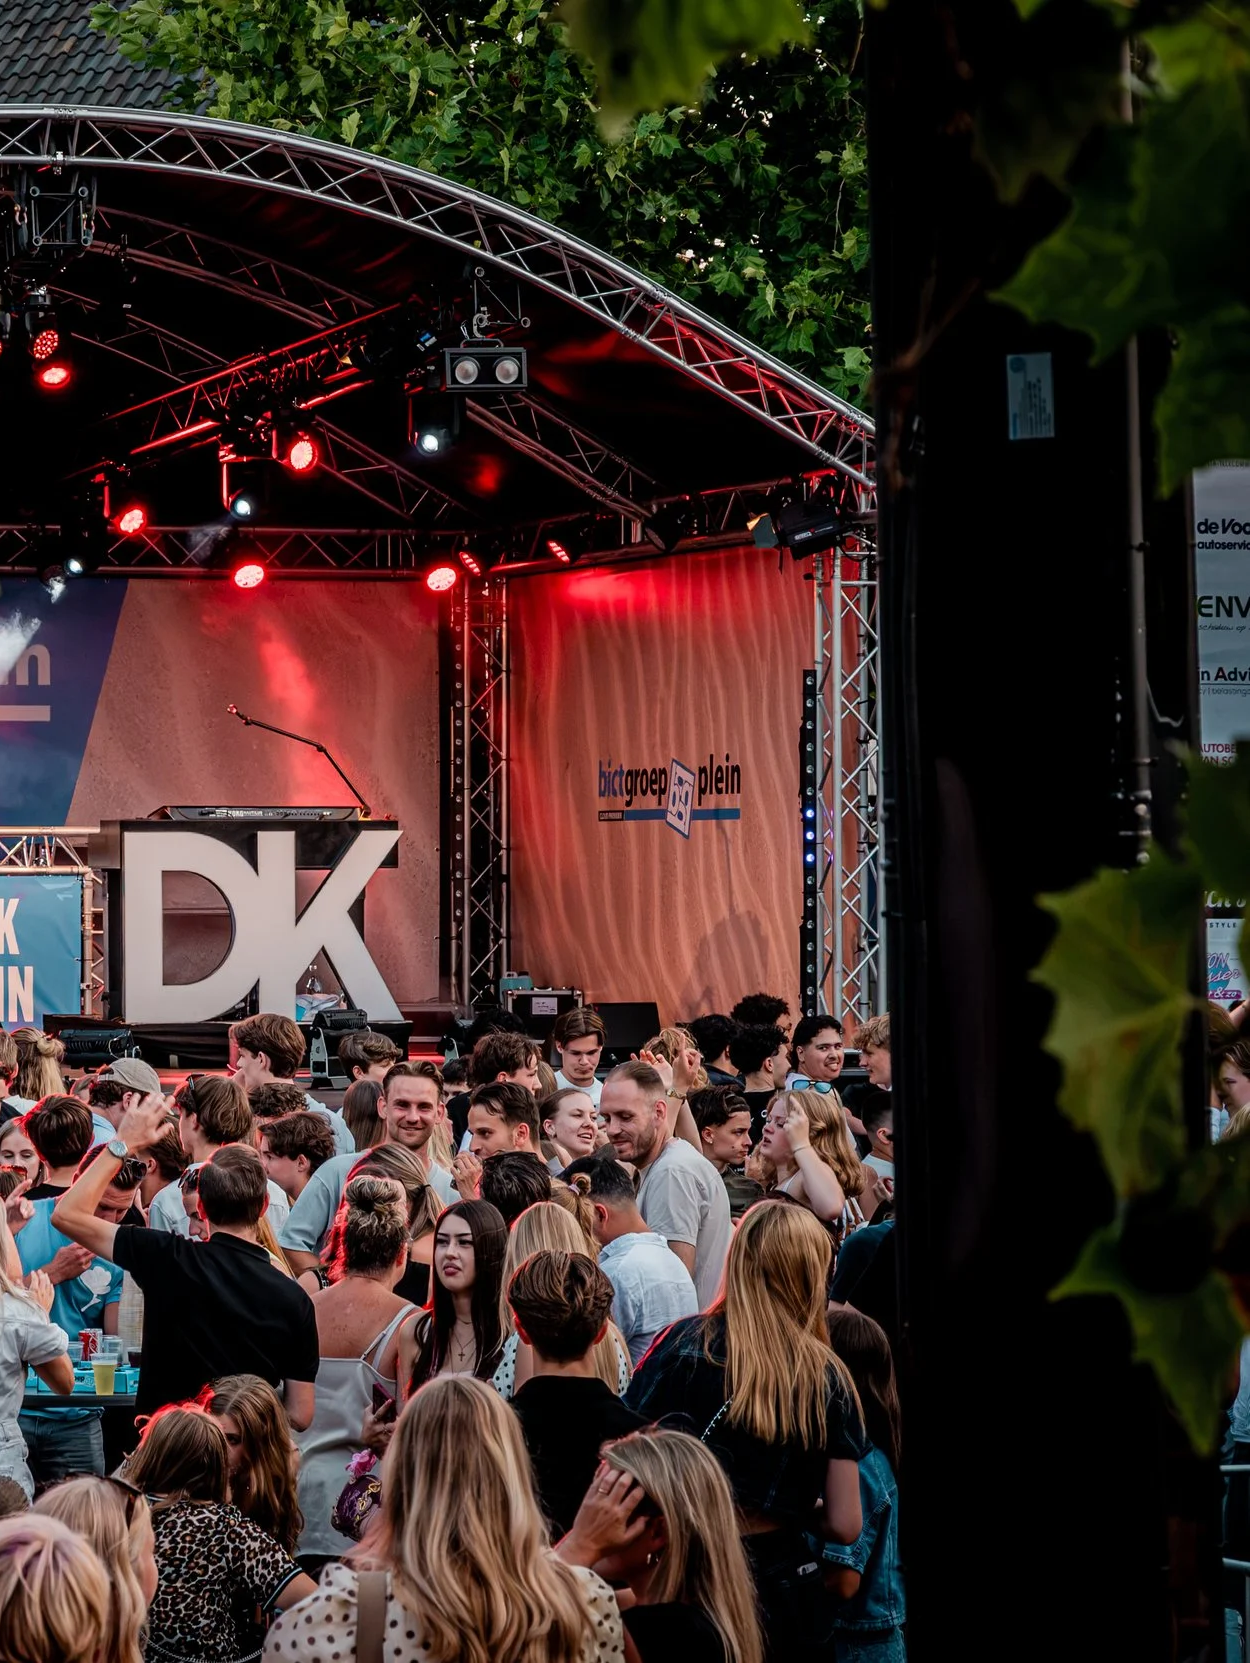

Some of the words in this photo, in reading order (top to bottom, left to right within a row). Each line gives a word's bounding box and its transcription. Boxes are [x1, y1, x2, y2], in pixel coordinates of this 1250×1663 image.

[598, 759, 668, 807] bictgroep
[698, 754, 741, 806] plein
[123, 830, 404, 1023] DK
